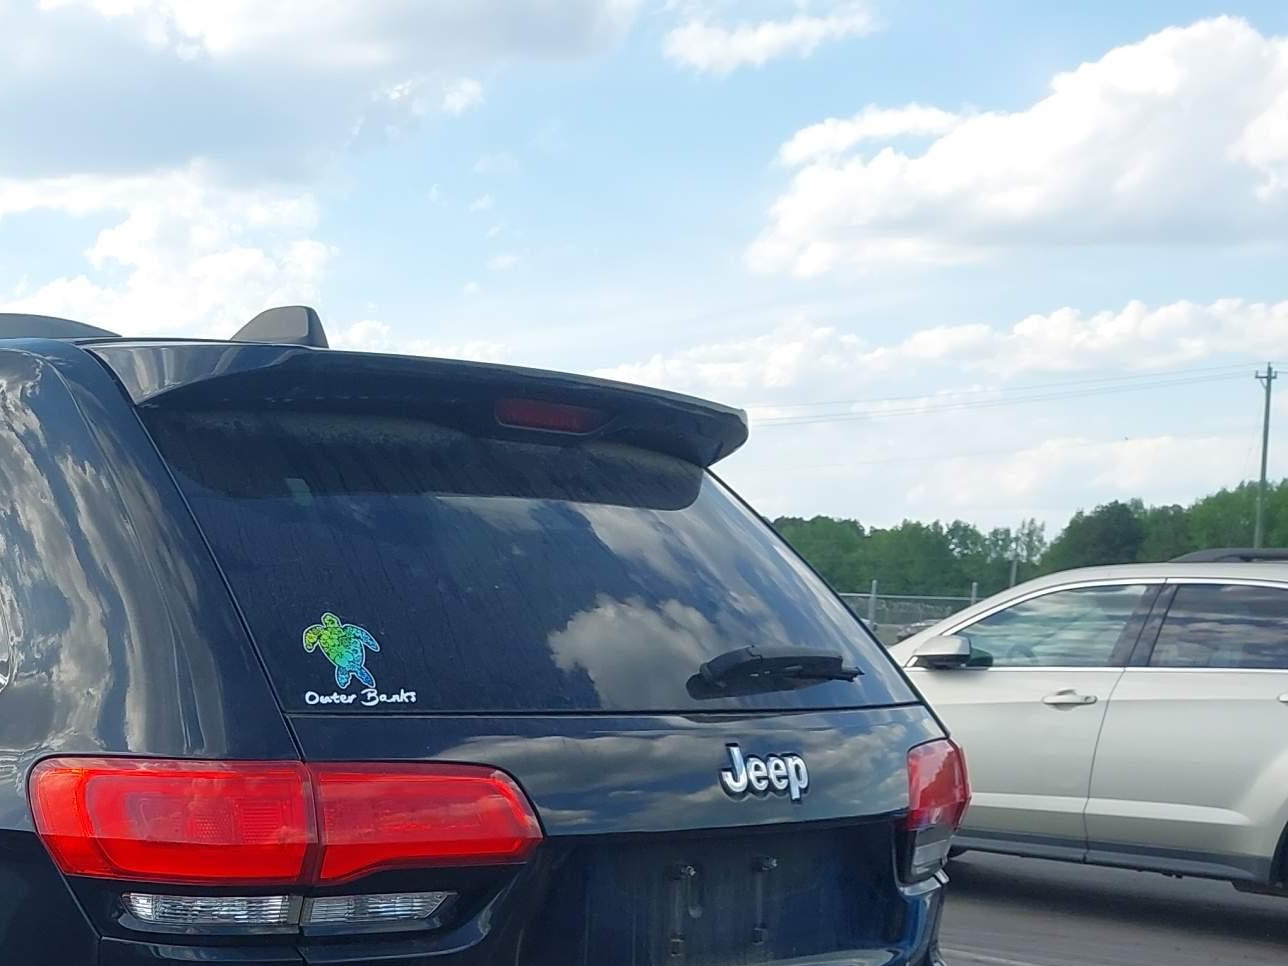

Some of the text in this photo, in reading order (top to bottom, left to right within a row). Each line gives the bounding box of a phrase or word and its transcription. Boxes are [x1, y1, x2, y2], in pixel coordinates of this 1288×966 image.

[305, 688, 417, 706] Outer Banks
[720, 743, 809, 801] Jeep
